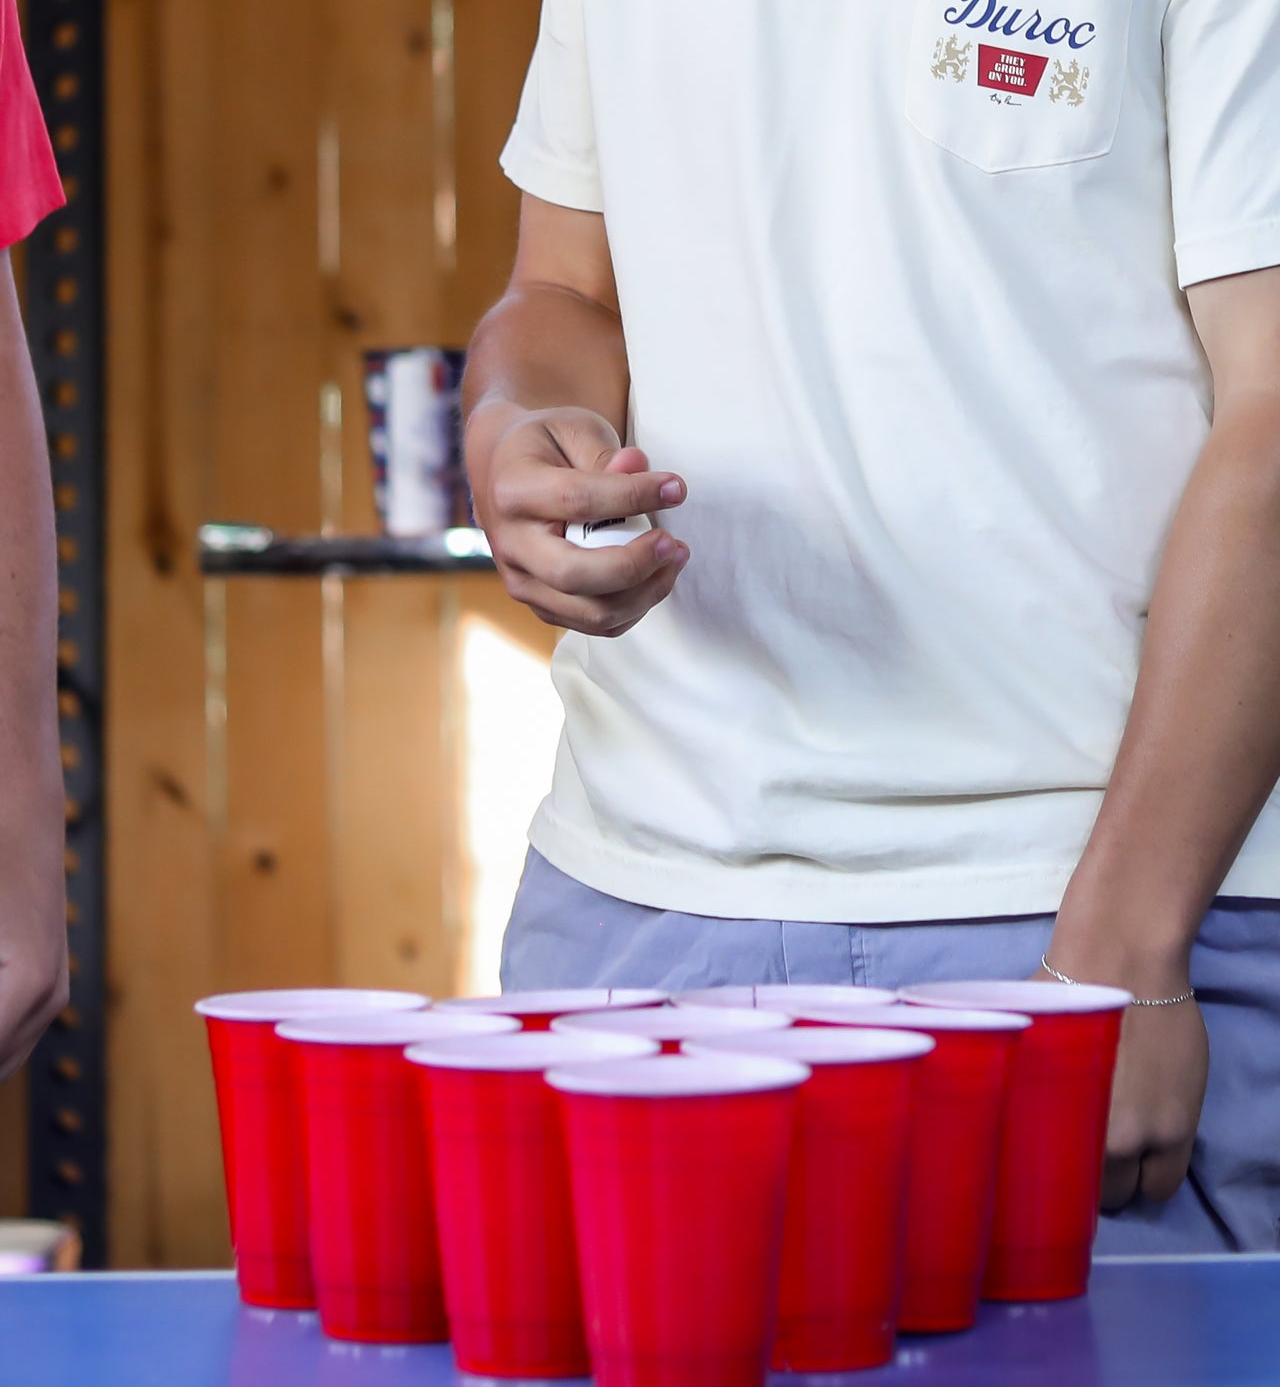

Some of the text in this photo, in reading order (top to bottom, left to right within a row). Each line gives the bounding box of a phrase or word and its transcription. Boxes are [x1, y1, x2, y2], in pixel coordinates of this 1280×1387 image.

[1000, 53, 1026, 67] THEY
[987, 71, 1002, 82] ON
[994, 62, 1026, 77] GROW
